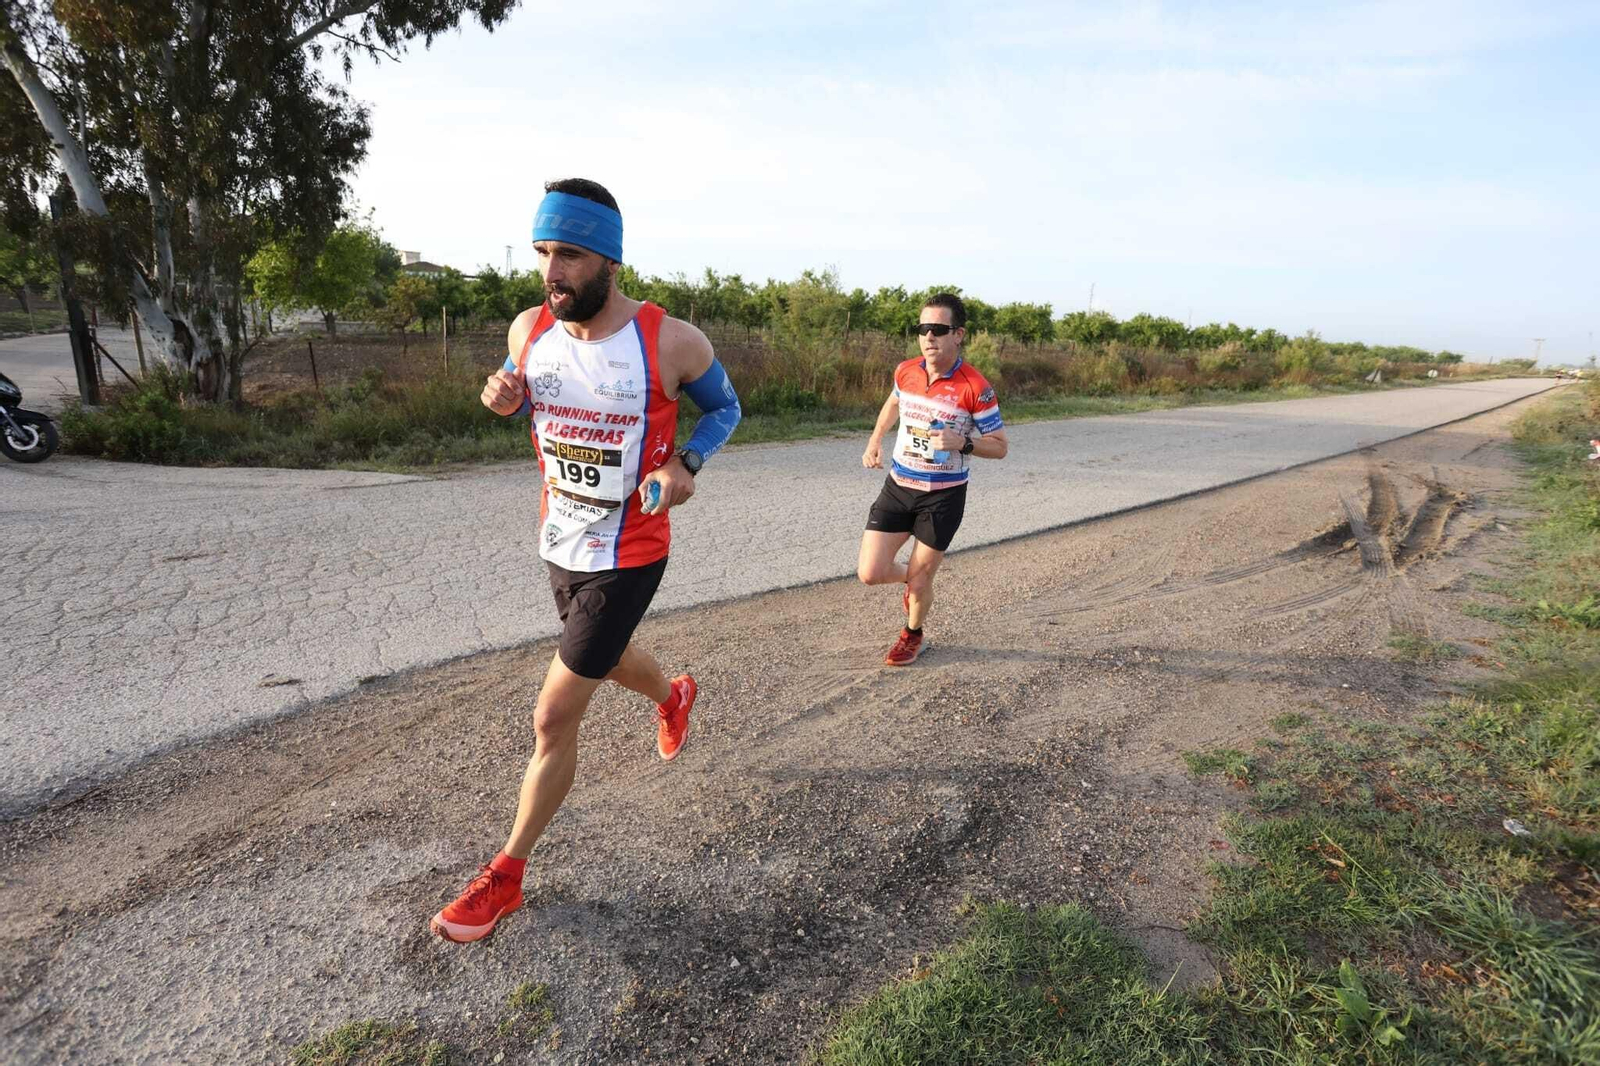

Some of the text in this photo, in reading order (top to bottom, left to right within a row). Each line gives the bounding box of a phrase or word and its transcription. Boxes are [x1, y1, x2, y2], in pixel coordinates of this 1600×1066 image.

[594, 388, 637, 400] EQUILIBRIUM
[548, 404, 601, 424] RUNNING
[604, 413, 640, 427] TEAM
[936, 410, 958, 421] TEAM
[544, 420, 625, 445] ALGECIRAS
[560, 444, 599, 462] Sherry
[556, 459, 600, 488] 199
